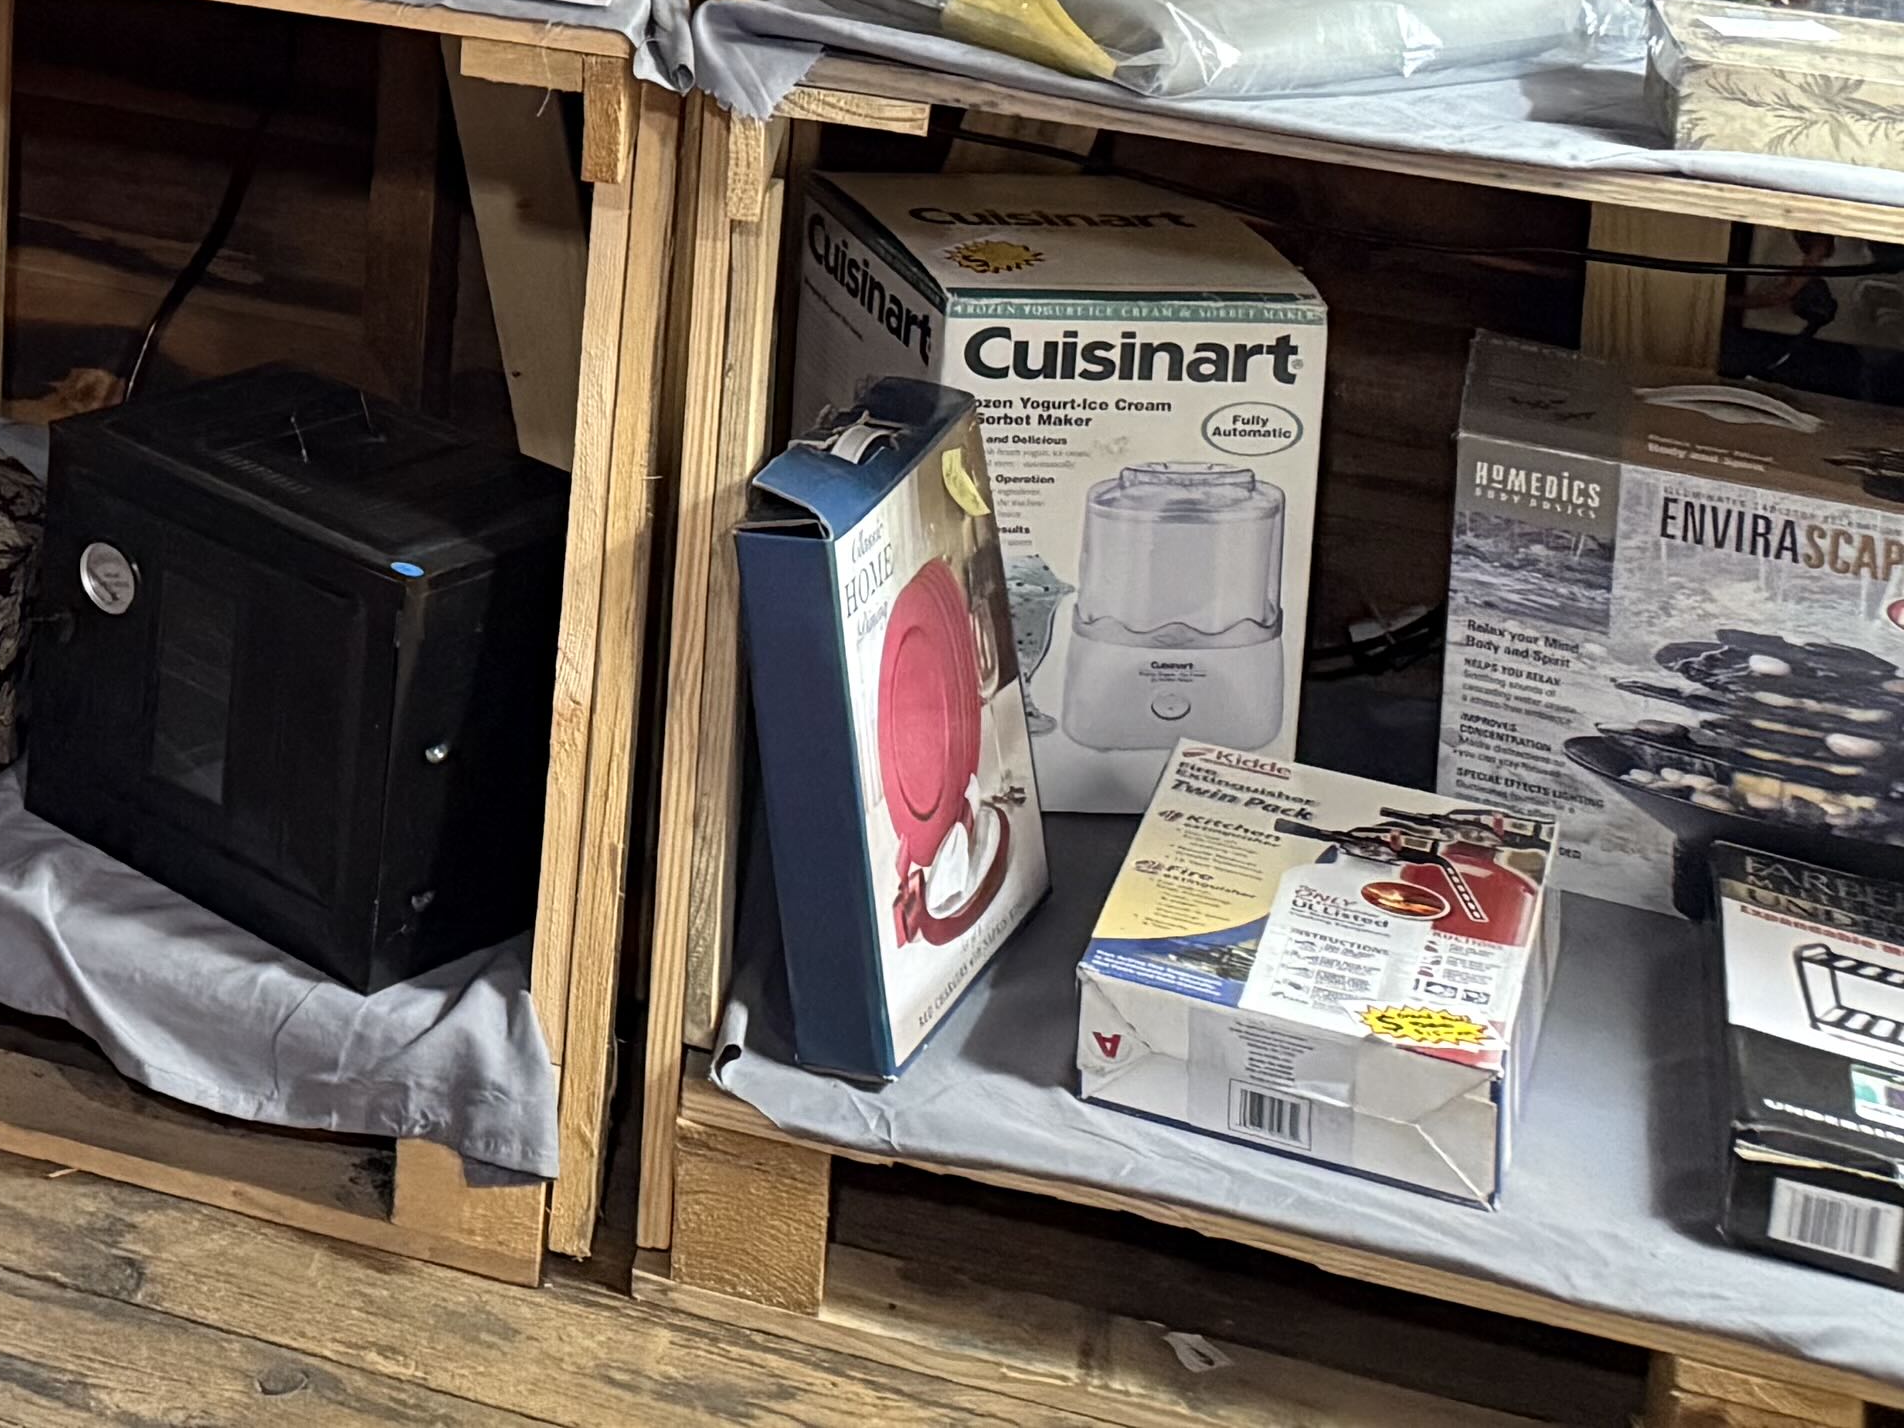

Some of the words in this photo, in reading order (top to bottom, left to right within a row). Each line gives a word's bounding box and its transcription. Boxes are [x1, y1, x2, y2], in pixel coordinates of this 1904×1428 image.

[908, 208, 1196, 230] Cuisinart
[807, 212, 931, 367] Cuisinart
[1023, 306, 1114, 318] YOGURT-ICE
[1121, 307, 1173, 319] CREAM
[1198, 308, 1257, 321] SORBET
[964, 326, 1299, 386] Cuisinart
[975, 399, 1013, 409] ozen
[1020, 398, 1108, 413] Yogurt-Ice
[1115, 399, 1172, 412] Cream
[976, 414, 1031, 427] Sorbet
[1038, 414, 1093, 427] Maker
[1212, 427, 1292, 439] Automatic
[1232, 415, 1269, 428] Fully
[986, 435, 1009, 444] and
[1012, 436, 1068, 445] Delicious
[996, 475, 1055, 485] Operation
[845, 542, 894, 619] HOME
[1467, 619, 1506, 637] Relax
[1509, 631, 1539, 644] your
[1466, 635, 1500, 654] Body
[1504, 646, 1528, 658] and
[1532, 650, 1570, 668] Spirit
[1464, 658, 1498, 672] HELPS
[1501, 664, 1523, 678] YOU
[1526, 671, 1561, 686] RELAX
[1460, 724, 1551, 752] CONCENTRATION
[1178, 761, 1217, 776] Fire
[1216, 750, 1291, 775] Kidde
[1171, 779, 1237, 804] Twin
[1244, 797, 1313, 820] Pack
[1176, 768, 1320, 807] Extinguisher
[1456, 768, 1500, 785] SPECIAL
[1504, 777, 1550, 794] EFFECTS
[1553, 789, 1604, 808] LIGHTING
[1186, 814, 1281, 841] Kitchen
[1166, 865, 1214, 881] Fire
[1292, 899, 1320, 911] UL
[1323, 904, 1389, 929] Listed
[1292, 927, 1389, 956] INSTRUCTIONS
